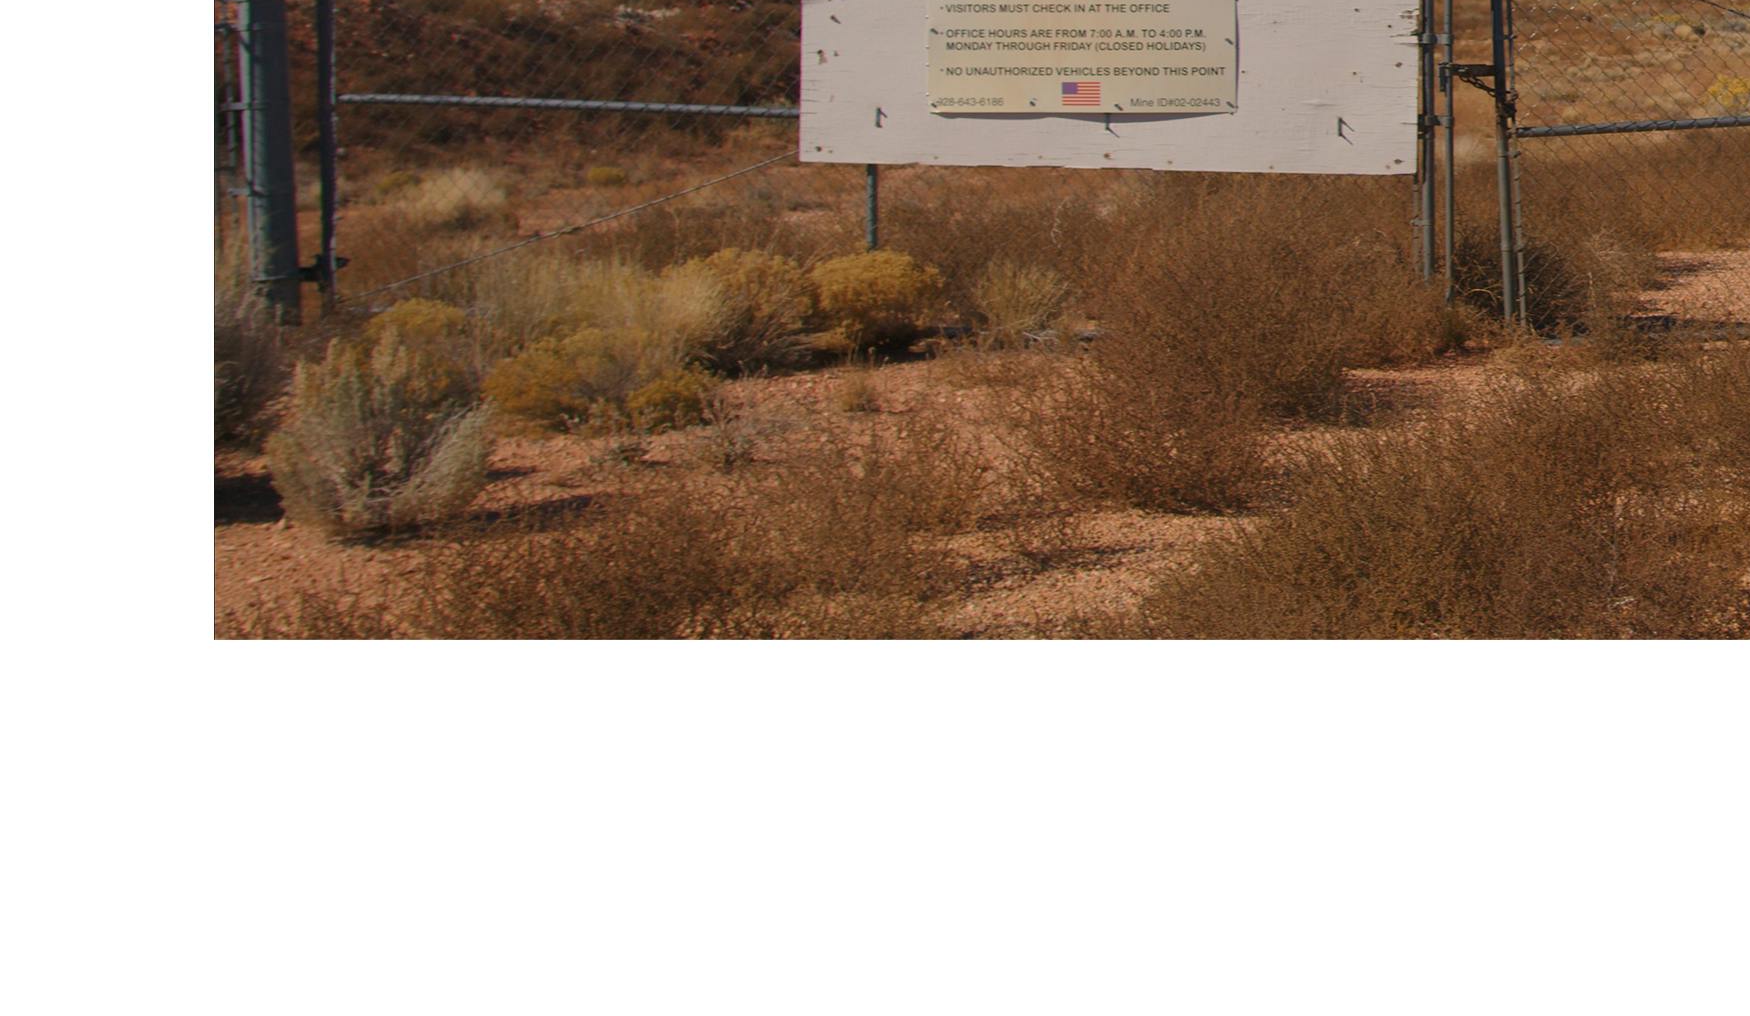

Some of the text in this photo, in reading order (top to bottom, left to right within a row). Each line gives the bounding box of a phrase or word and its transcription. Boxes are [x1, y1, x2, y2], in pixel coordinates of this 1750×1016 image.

[945, 3, 1170, 14] VISITORS MUST CHECK IN AT THE OFFICE
[945, 28, 1207, 39] OFFICE HOURS ARE FROM 7:00 A.M. TO 4:00 P.M.
[945, 41, 1207, 52] MONDAY THROUGH FRIDAY (CLOSED HOLIDAYS)
[945, 66, 1226, 77] NO UNAUTHORIZED VEHICLES BEYOND THIS POINT
[1130, 98, 1155, 107] Mine
